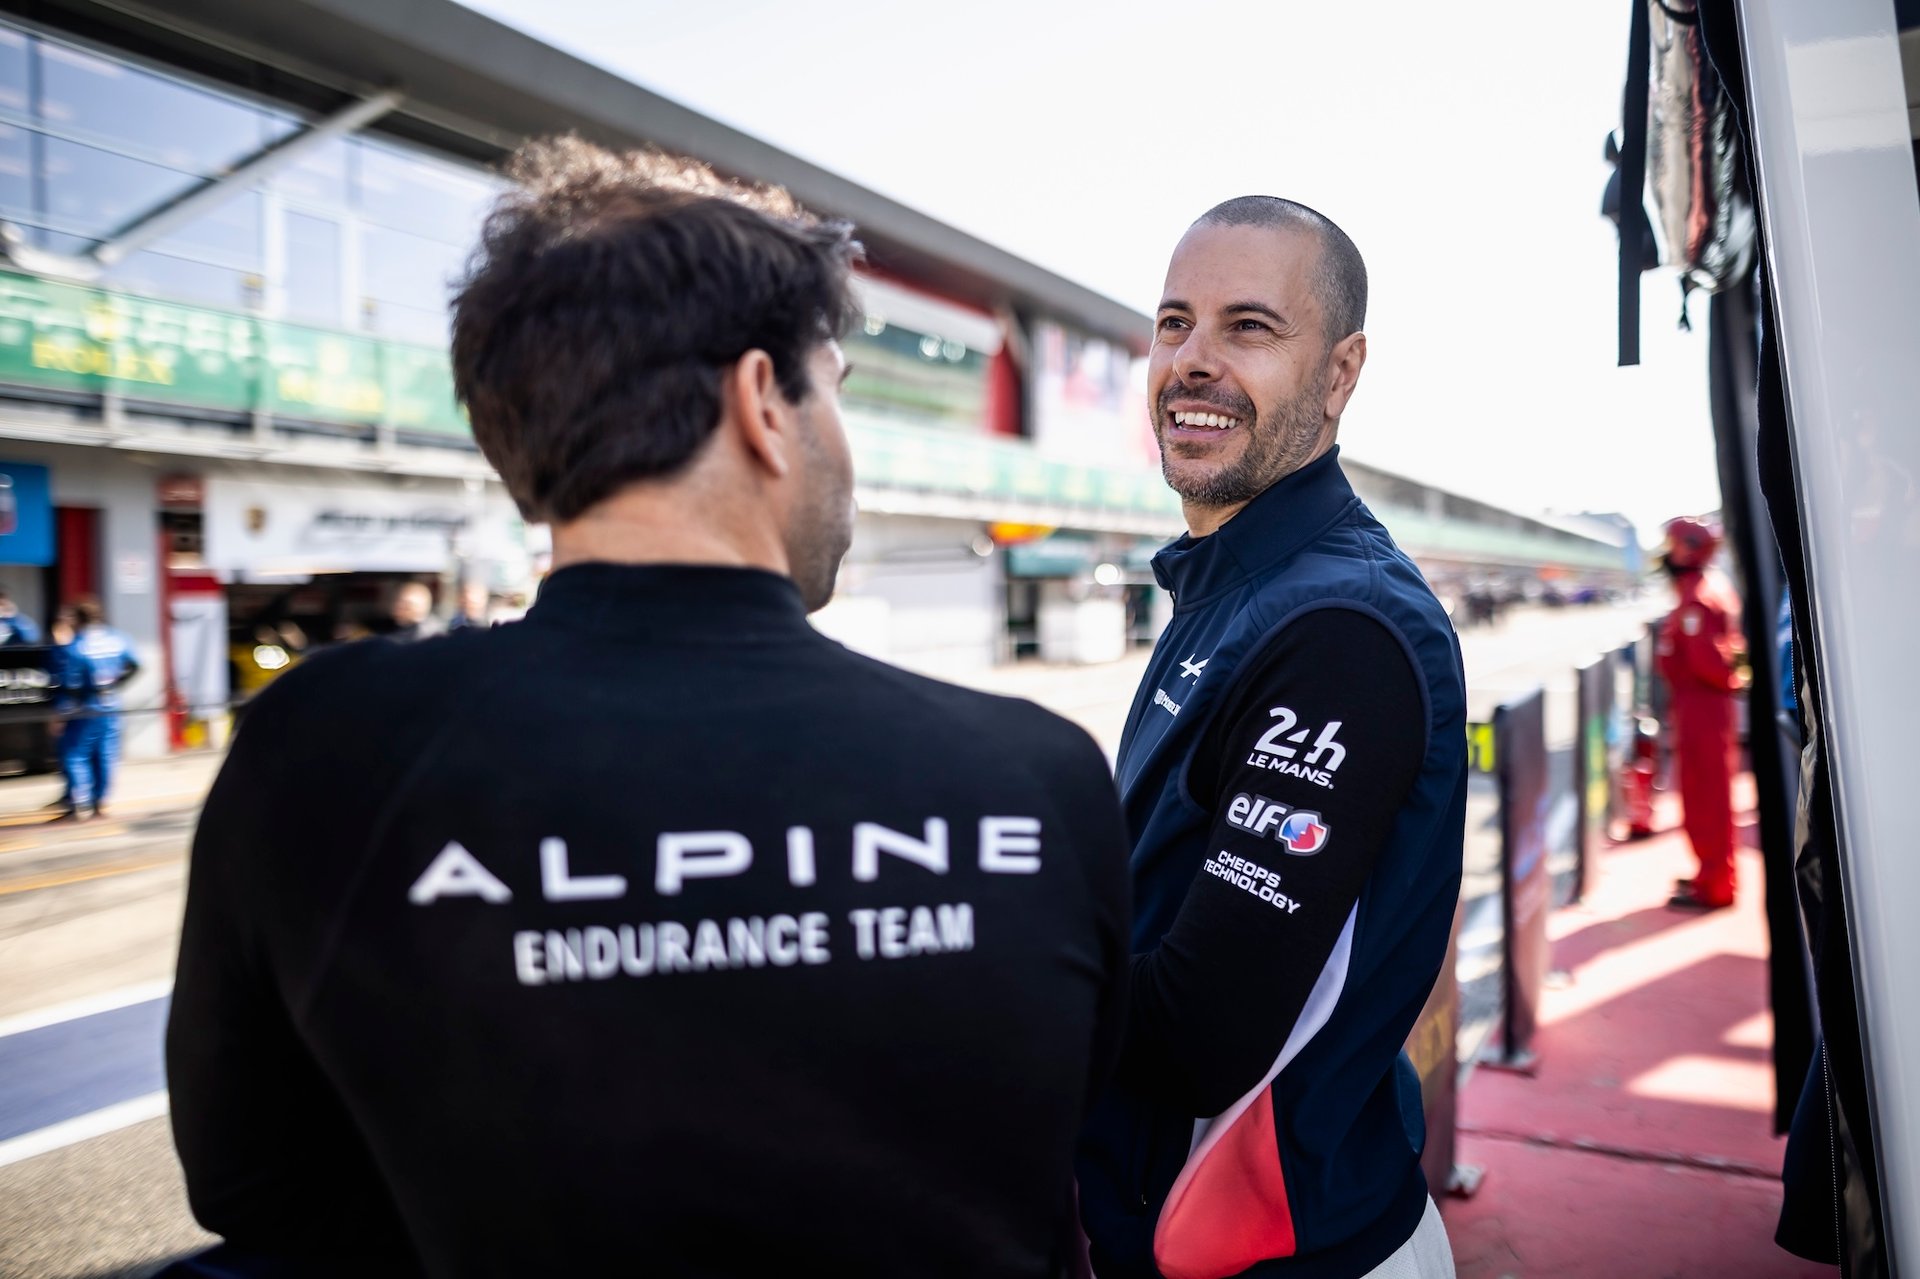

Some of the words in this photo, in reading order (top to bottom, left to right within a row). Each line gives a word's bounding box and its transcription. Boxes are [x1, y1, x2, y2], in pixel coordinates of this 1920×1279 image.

[1246, 752, 1270, 769] LE
[1227, 796, 1288, 833] elf
[408, 815, 1042, 905] ALPINE
[1217, 850, 1282, 888] CHEOPS
[1203, 858, 1301, 915] TECHNOLOGY
[512, 911, 831, 986] ENDURANCE
[848, 902, 975, 960] TEAM
